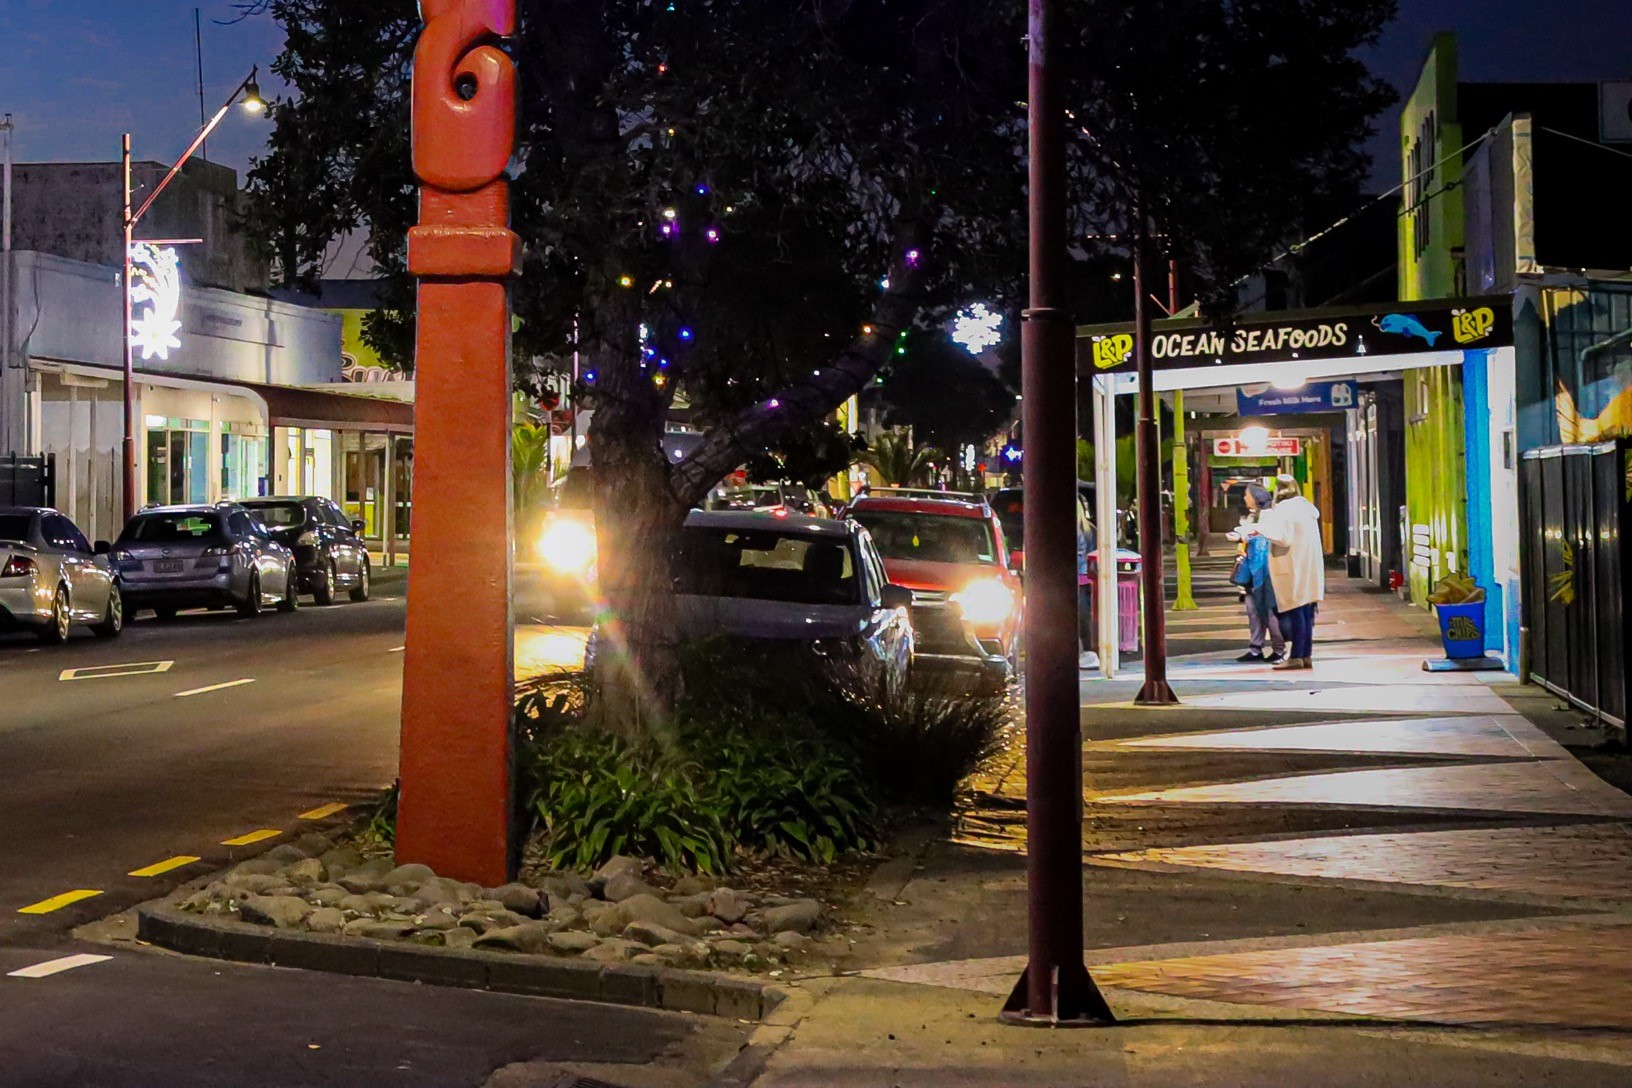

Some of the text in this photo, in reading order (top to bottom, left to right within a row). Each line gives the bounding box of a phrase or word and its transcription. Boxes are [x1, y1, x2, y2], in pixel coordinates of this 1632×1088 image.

[1152, 323, 1348, 358] OCEAN SEAFOODS
[1452, 307, 1494, 343] L&P
[1093, 334, 1133, 369] L&P
